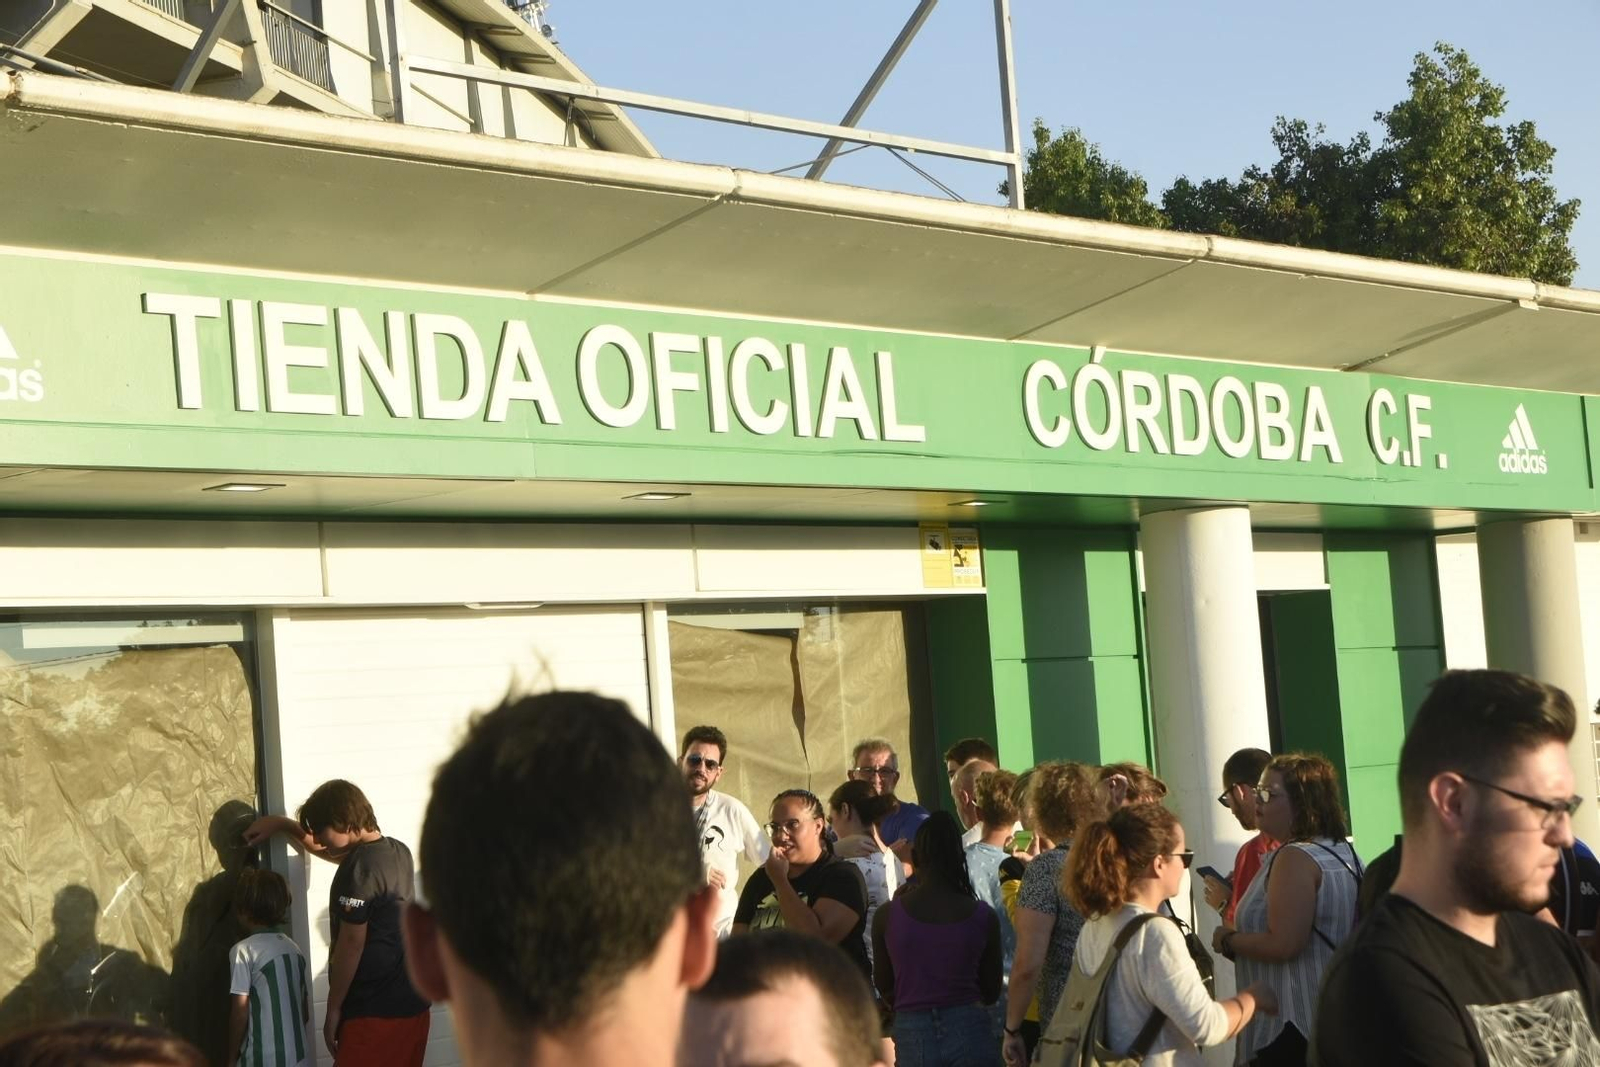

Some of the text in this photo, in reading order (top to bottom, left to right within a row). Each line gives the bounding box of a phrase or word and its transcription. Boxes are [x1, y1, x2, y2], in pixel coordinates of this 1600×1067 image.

[141, 292, 1449, 469] TIENDA OFICIAL CÓRDOBA C.F.
[1498, 448, 1548, 475] adidas
